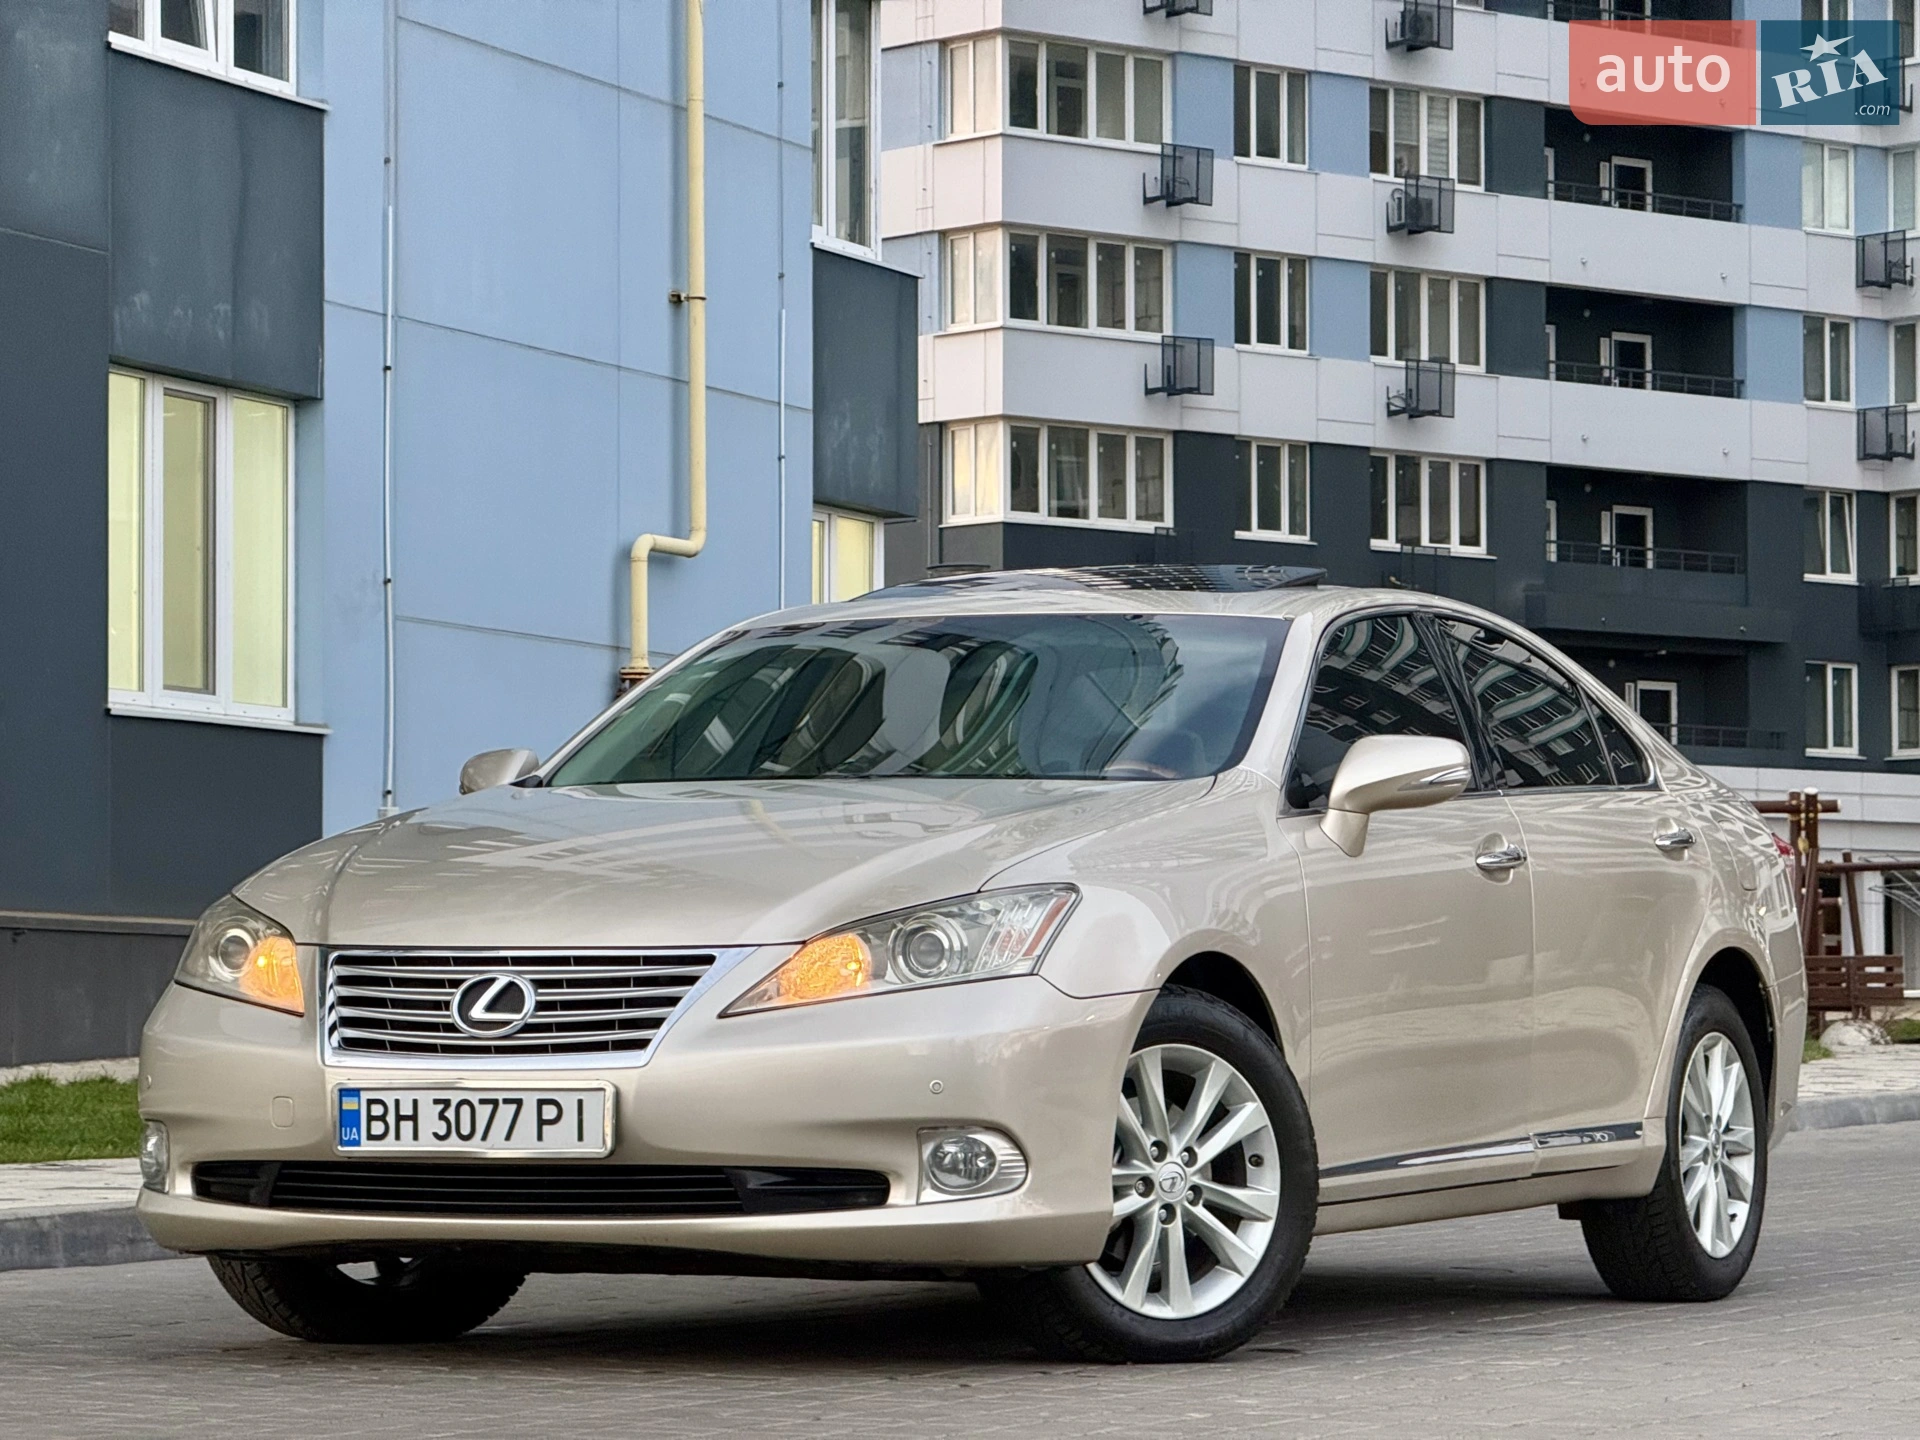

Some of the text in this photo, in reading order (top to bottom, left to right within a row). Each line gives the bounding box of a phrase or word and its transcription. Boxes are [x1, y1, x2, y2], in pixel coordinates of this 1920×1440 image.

[341, 1127, 359, 1141] UA
[366, 1098, 584, 1142] BH 3077 PI
